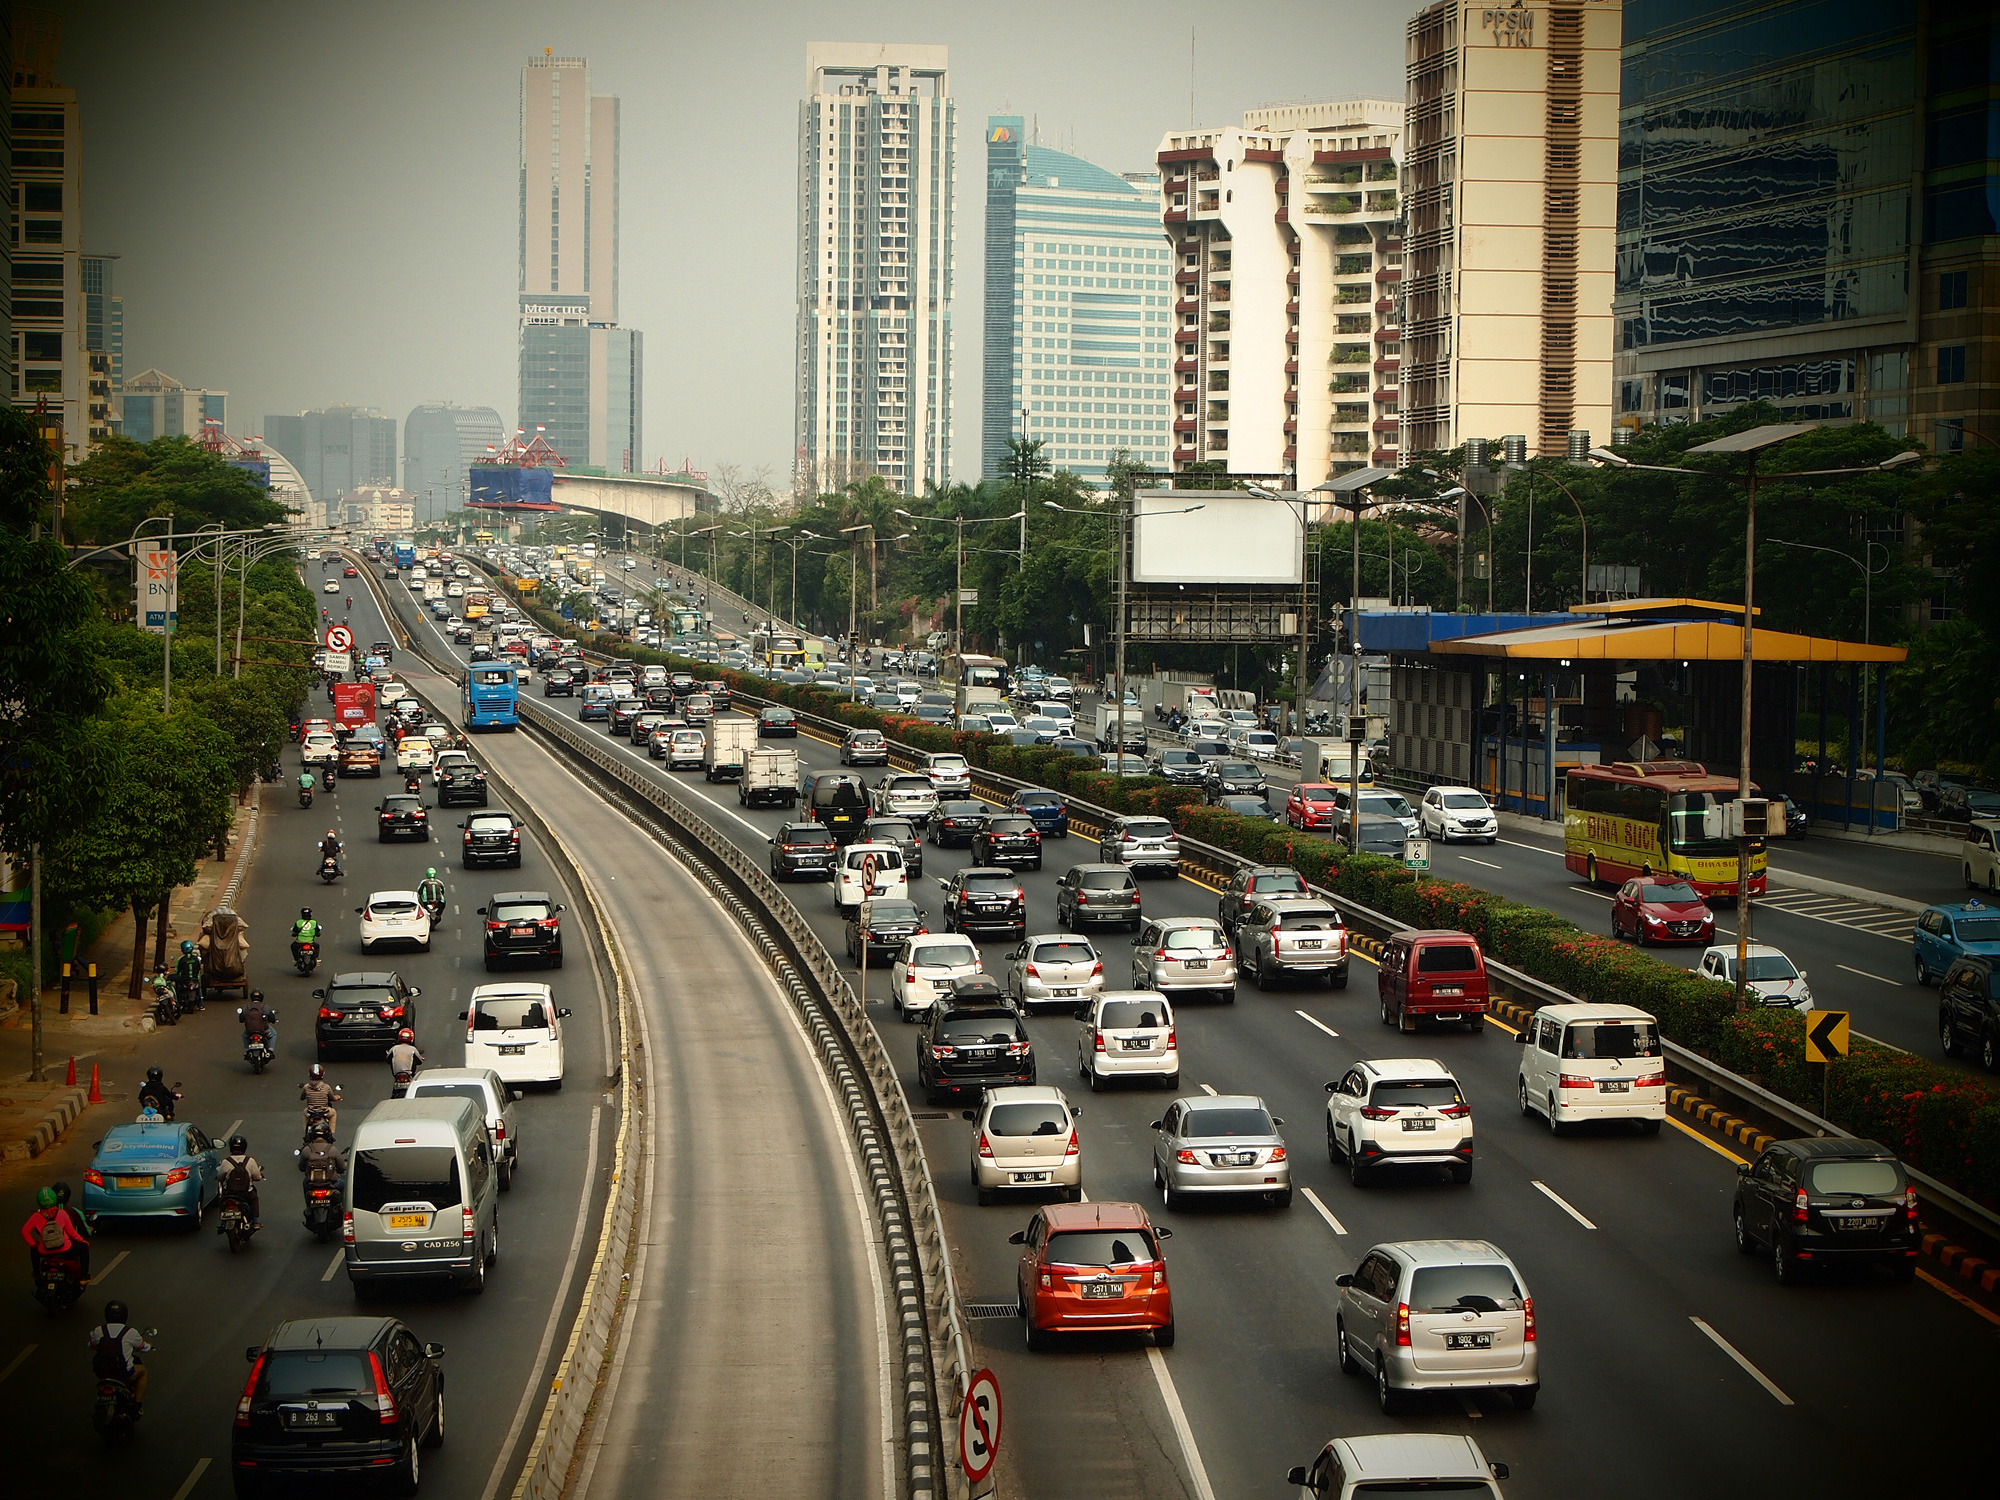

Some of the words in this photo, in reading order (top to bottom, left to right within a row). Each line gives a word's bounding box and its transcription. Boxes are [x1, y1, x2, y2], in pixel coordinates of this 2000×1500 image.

[1482, 10, 1534, 30] PPSM
[1493, 30, 1534, 47] YTKI
[524, 303, 587, 315] Mercure
[526, 316, 559, 325] HOTEL
[1624, 821, 1655, 852] SUCI
[1413, 849, 1420, 859] 6
[123, 1143, 175, 1151] MyBlueBird
[1847, 1218, 1863, 1226] 2207
[443, 1240, 460, 1248] 1256
[1083, 1284, 1088, 1293] B
[1092, 1284, 1108, 1293] 2571
[1448, 1336, 1453, 1345] B
[1457, 1335, 1472, 1345] 1902
[1477, 1334, 1490, 1344] KFN
[291, 1413, 297, 1422] B
[305, 1412, 318, 1421] 263
[325, 1412, 335, 1421] SL
